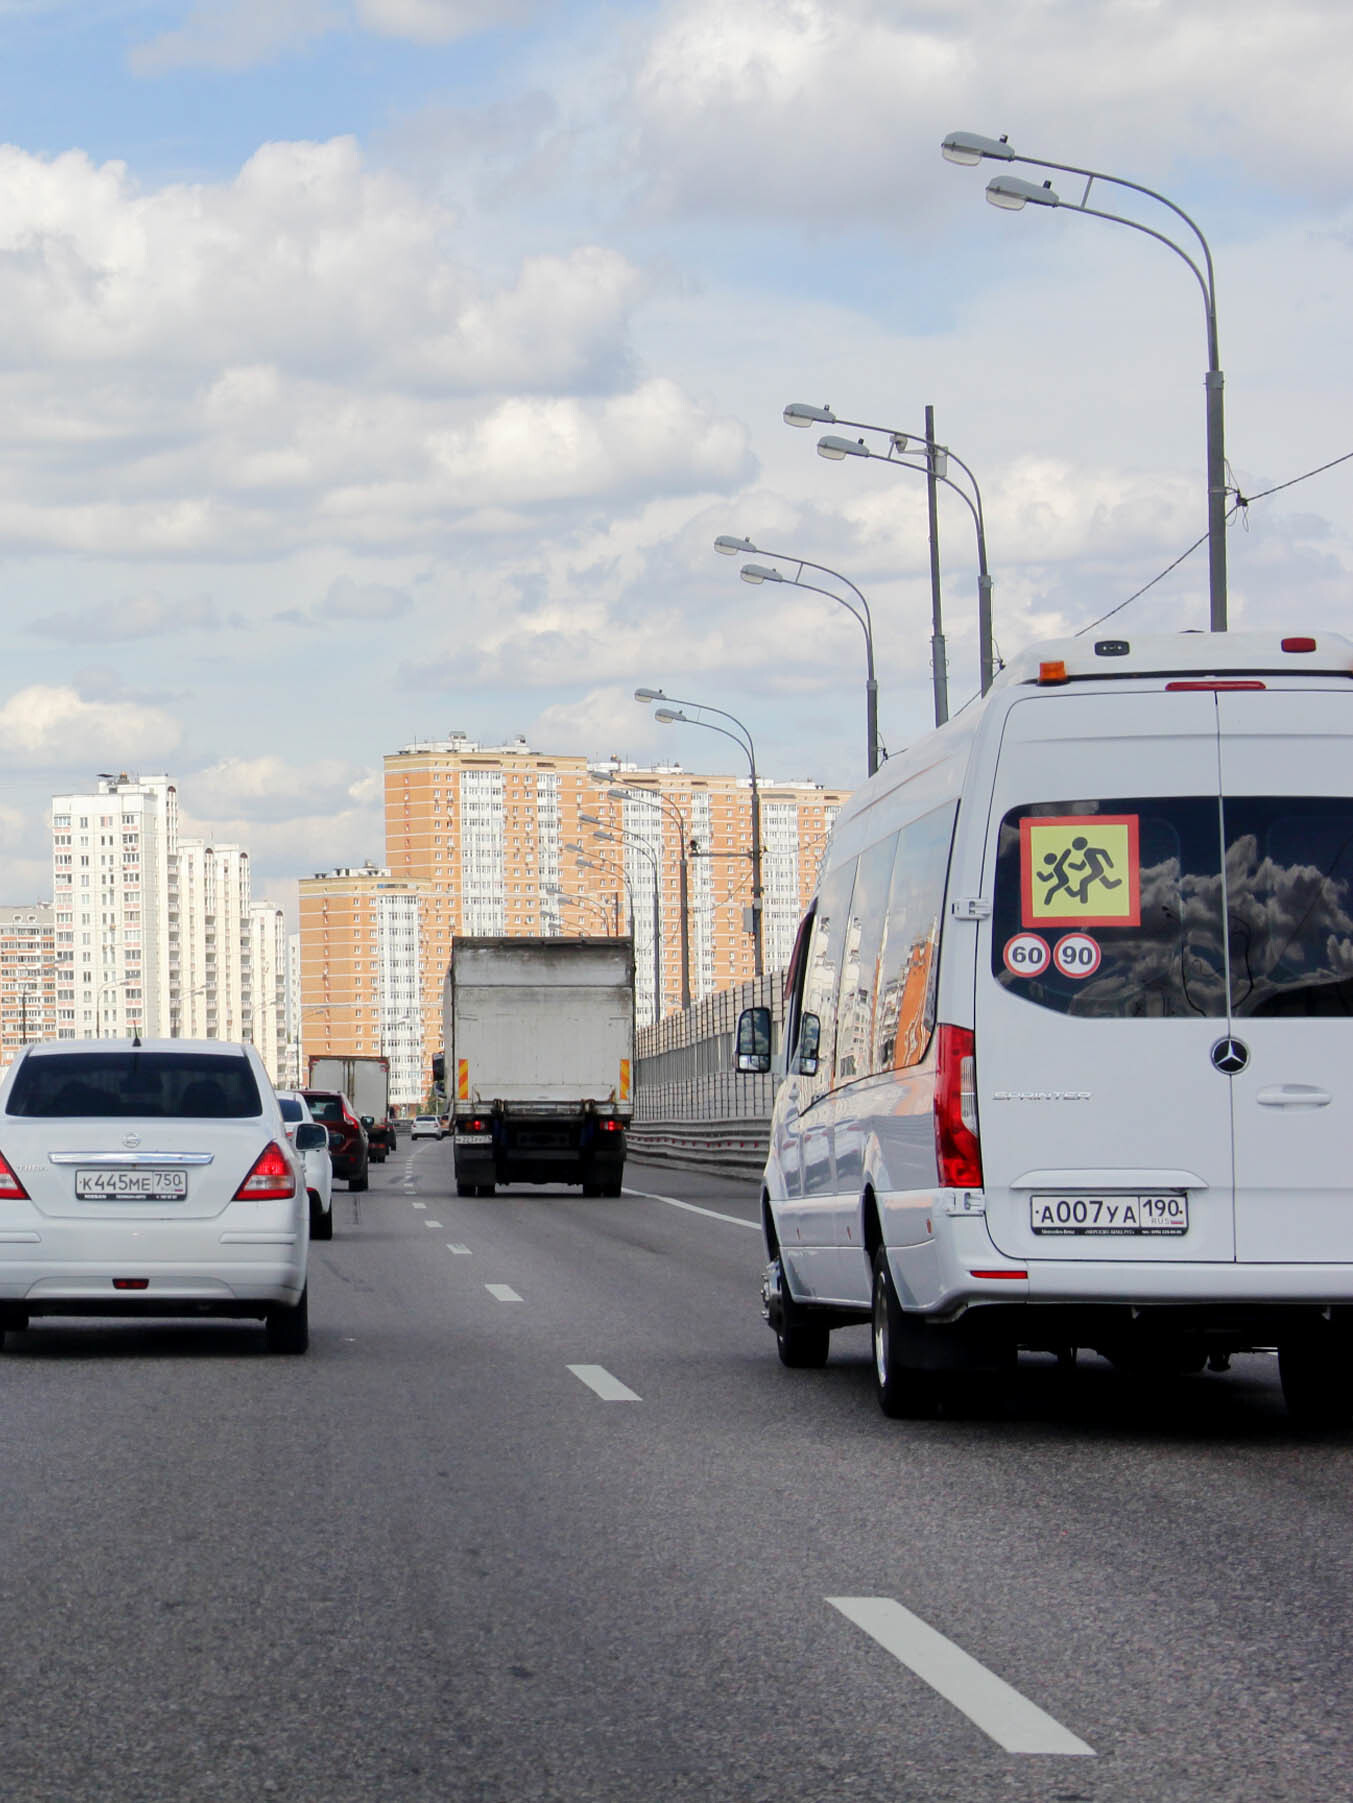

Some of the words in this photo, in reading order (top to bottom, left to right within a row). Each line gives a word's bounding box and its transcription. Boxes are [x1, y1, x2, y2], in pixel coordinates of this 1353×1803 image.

[1011, 946, 1043, 965] 60
[1062, 945, 1093, 966] 90
[82, 1174, 151, 1191] К445МЕ
[155, 1173, 181, 1187] 750
[1041, 1200, 1137, 1224] А007УА
[1142, 1199, 1180, 1217] 190
[1150, 1217, 1170, 1225] RUS
